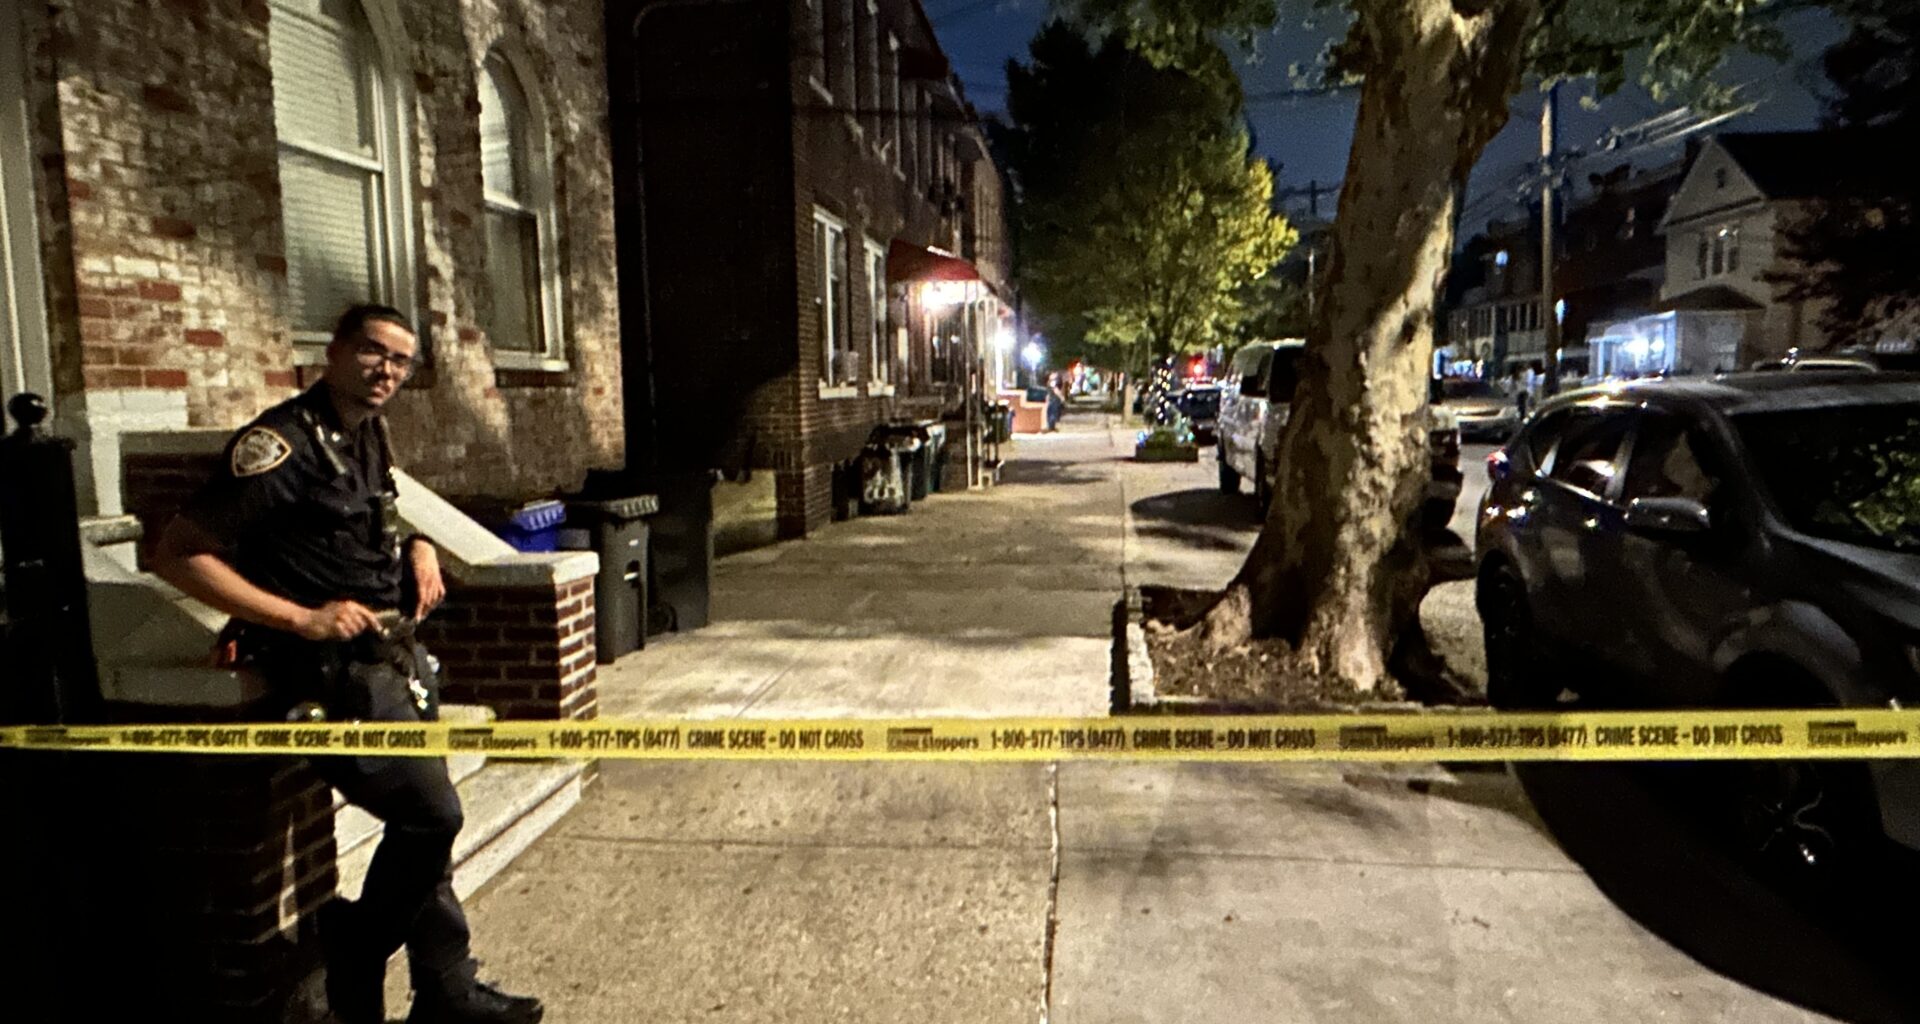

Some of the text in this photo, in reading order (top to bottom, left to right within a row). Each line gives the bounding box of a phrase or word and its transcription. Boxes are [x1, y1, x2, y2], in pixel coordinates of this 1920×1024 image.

[255, 730, 292, 748] CRIME
[295, 730, 331, 748] SCENE
[344, 730, 359, 748] DO
[362, 730, 385, 748] NOT
[387, 730, 427, 748] CROSS
[549, 729, 641, 748] 1-800-577-TIPS
[643, 729, 681, 749] (8477)
[687, 729, 725, 748] CRIME
[728, 729, 766, 748] SCENE
[779, 729, 796, 748] DO
[799, 729, 822, 748] NOT
[825, 729, 864, 748] CROSS
[991, 729, 1085, 749] 1-800-577-TIPS
[1087, 728, 1126, 749] (8477)
[1133, 728, 1171, 748] CRIME
[1175, 728, 1214, 748] SCENE
[1228, 728, 1245, 748] DO
[1248, 728, 1272, 748] NOT
[1275, 728, 1316, 748] CROSS
[1595, 726, 1635, 746] CRIME
[1639, 726, 1679, 745] SCENE
[1693, 725, 1710, 745] DO
[1713, 725, 1738, 744] NOT
[1741, 725, 1783, 745] CROSS
